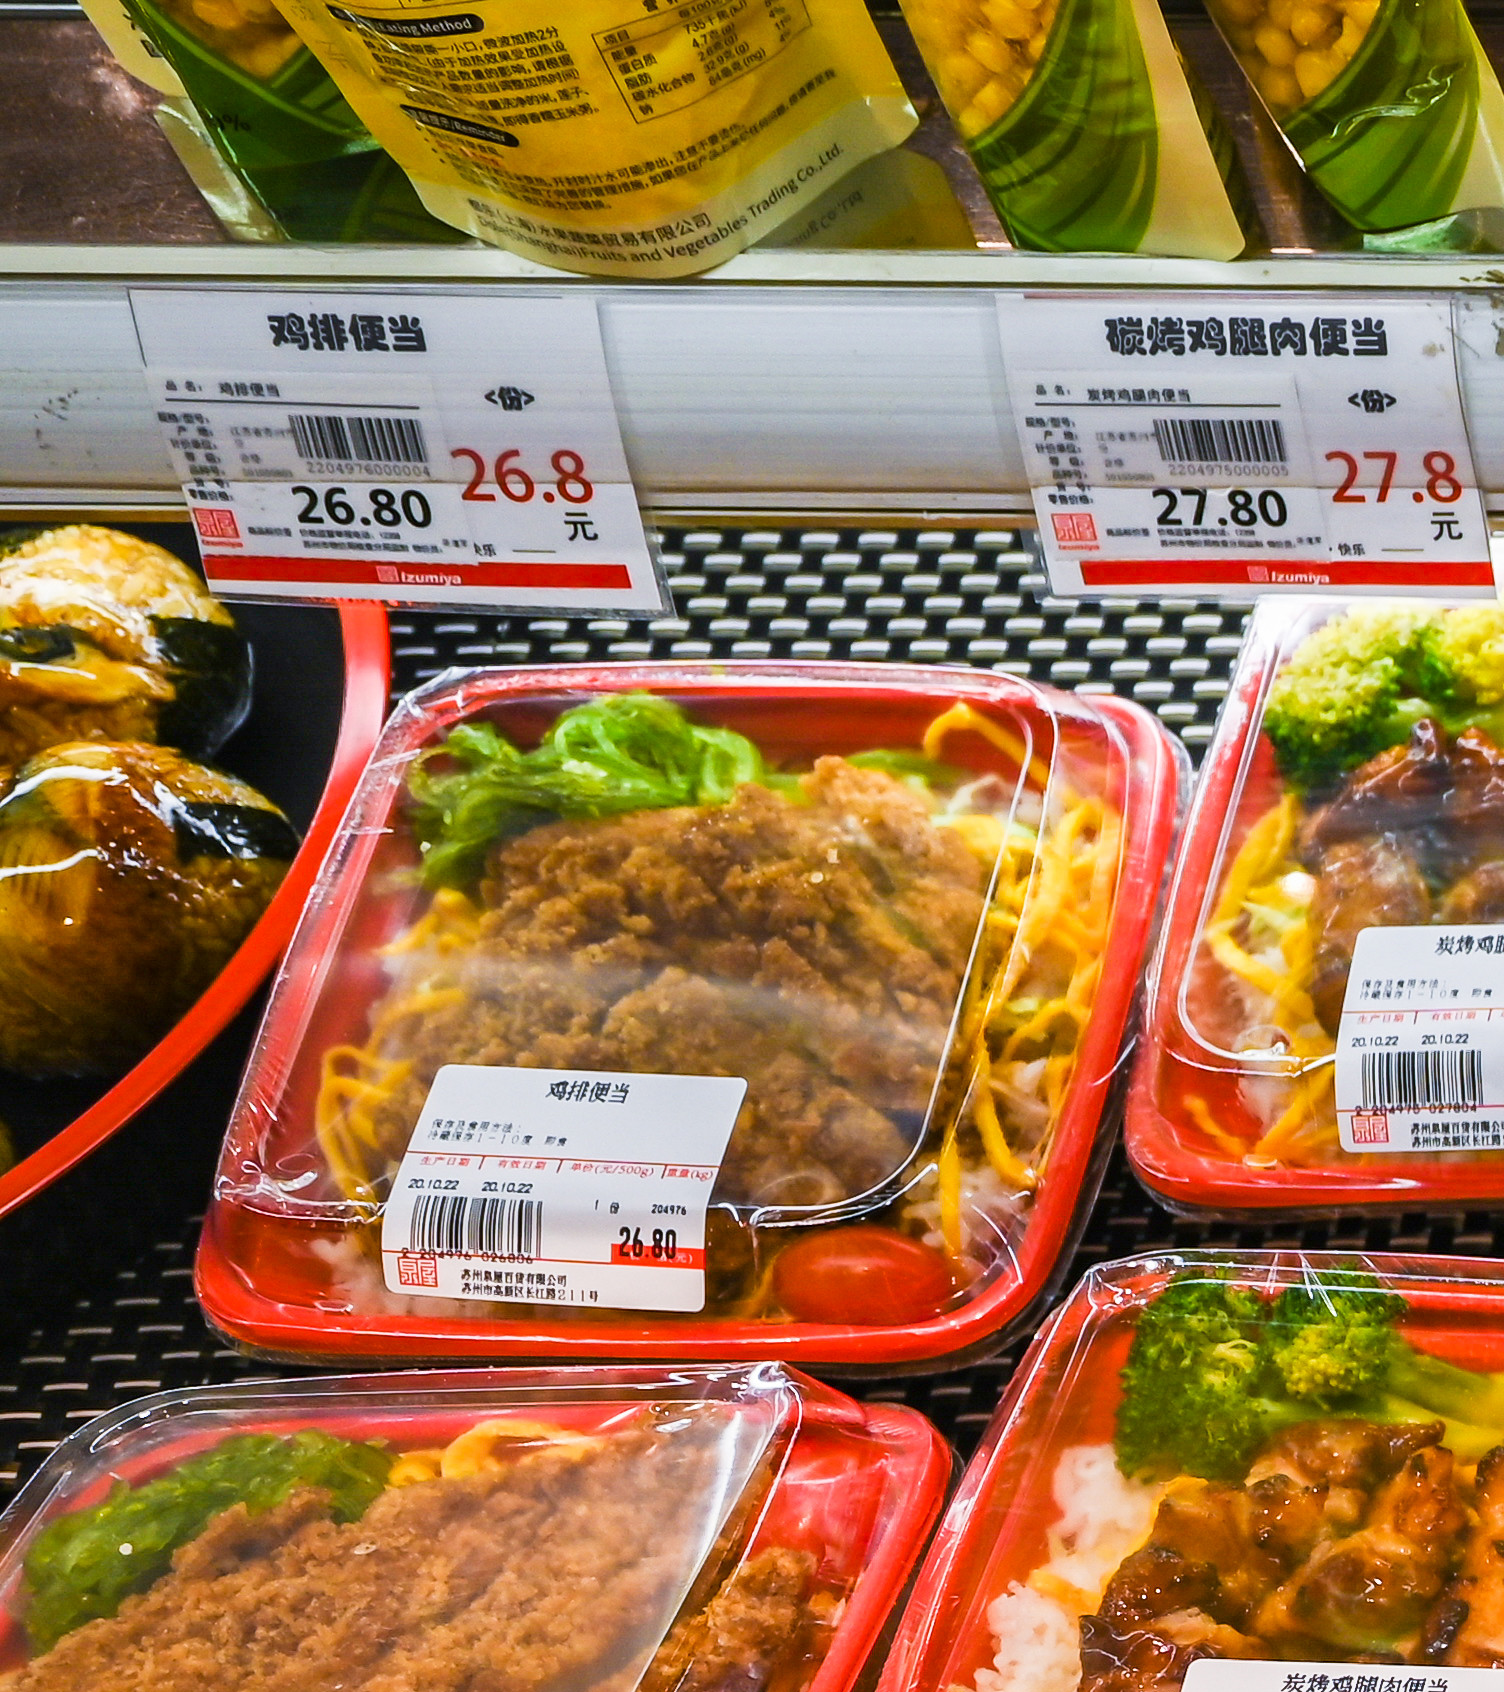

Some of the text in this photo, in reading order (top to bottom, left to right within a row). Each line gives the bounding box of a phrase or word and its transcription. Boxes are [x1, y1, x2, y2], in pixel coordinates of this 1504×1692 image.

[631, 246, 661, 263] and
[662, 216, 749, 258] Vegetables
[747, 178, 799, 220] Trading
[267, 313, 427, 353] 鸡排便当
[1105, 317, 1387, 357] 碳烤鸡腿肉便当
[306, 461, 431, 478] 2204976000004
[451, 448, 595, 503] 26.8
[1168, 463, 1289, 477] 2204975000005
[1325, 450, 1463, 504] 27.8
[291, 485, 432, 529] 26.80
[1152, 488, 1288, 528] 27.80
[564, 511, 598, 542] 元
[1430, 511, 1463, 541] 元
[401, 571, 462, 586] Izumiya
[1271, 570, 1330, 585] Izumiya
[1351, 1033, 1469, 1048] 20.10.22 20.10.22
[546, 1080, 630, 1104] 鸡排便当
[408, 1178, 533, 1194] 20.10.22 20.10.22
[618, 1226, 676, 1259] 26.80
